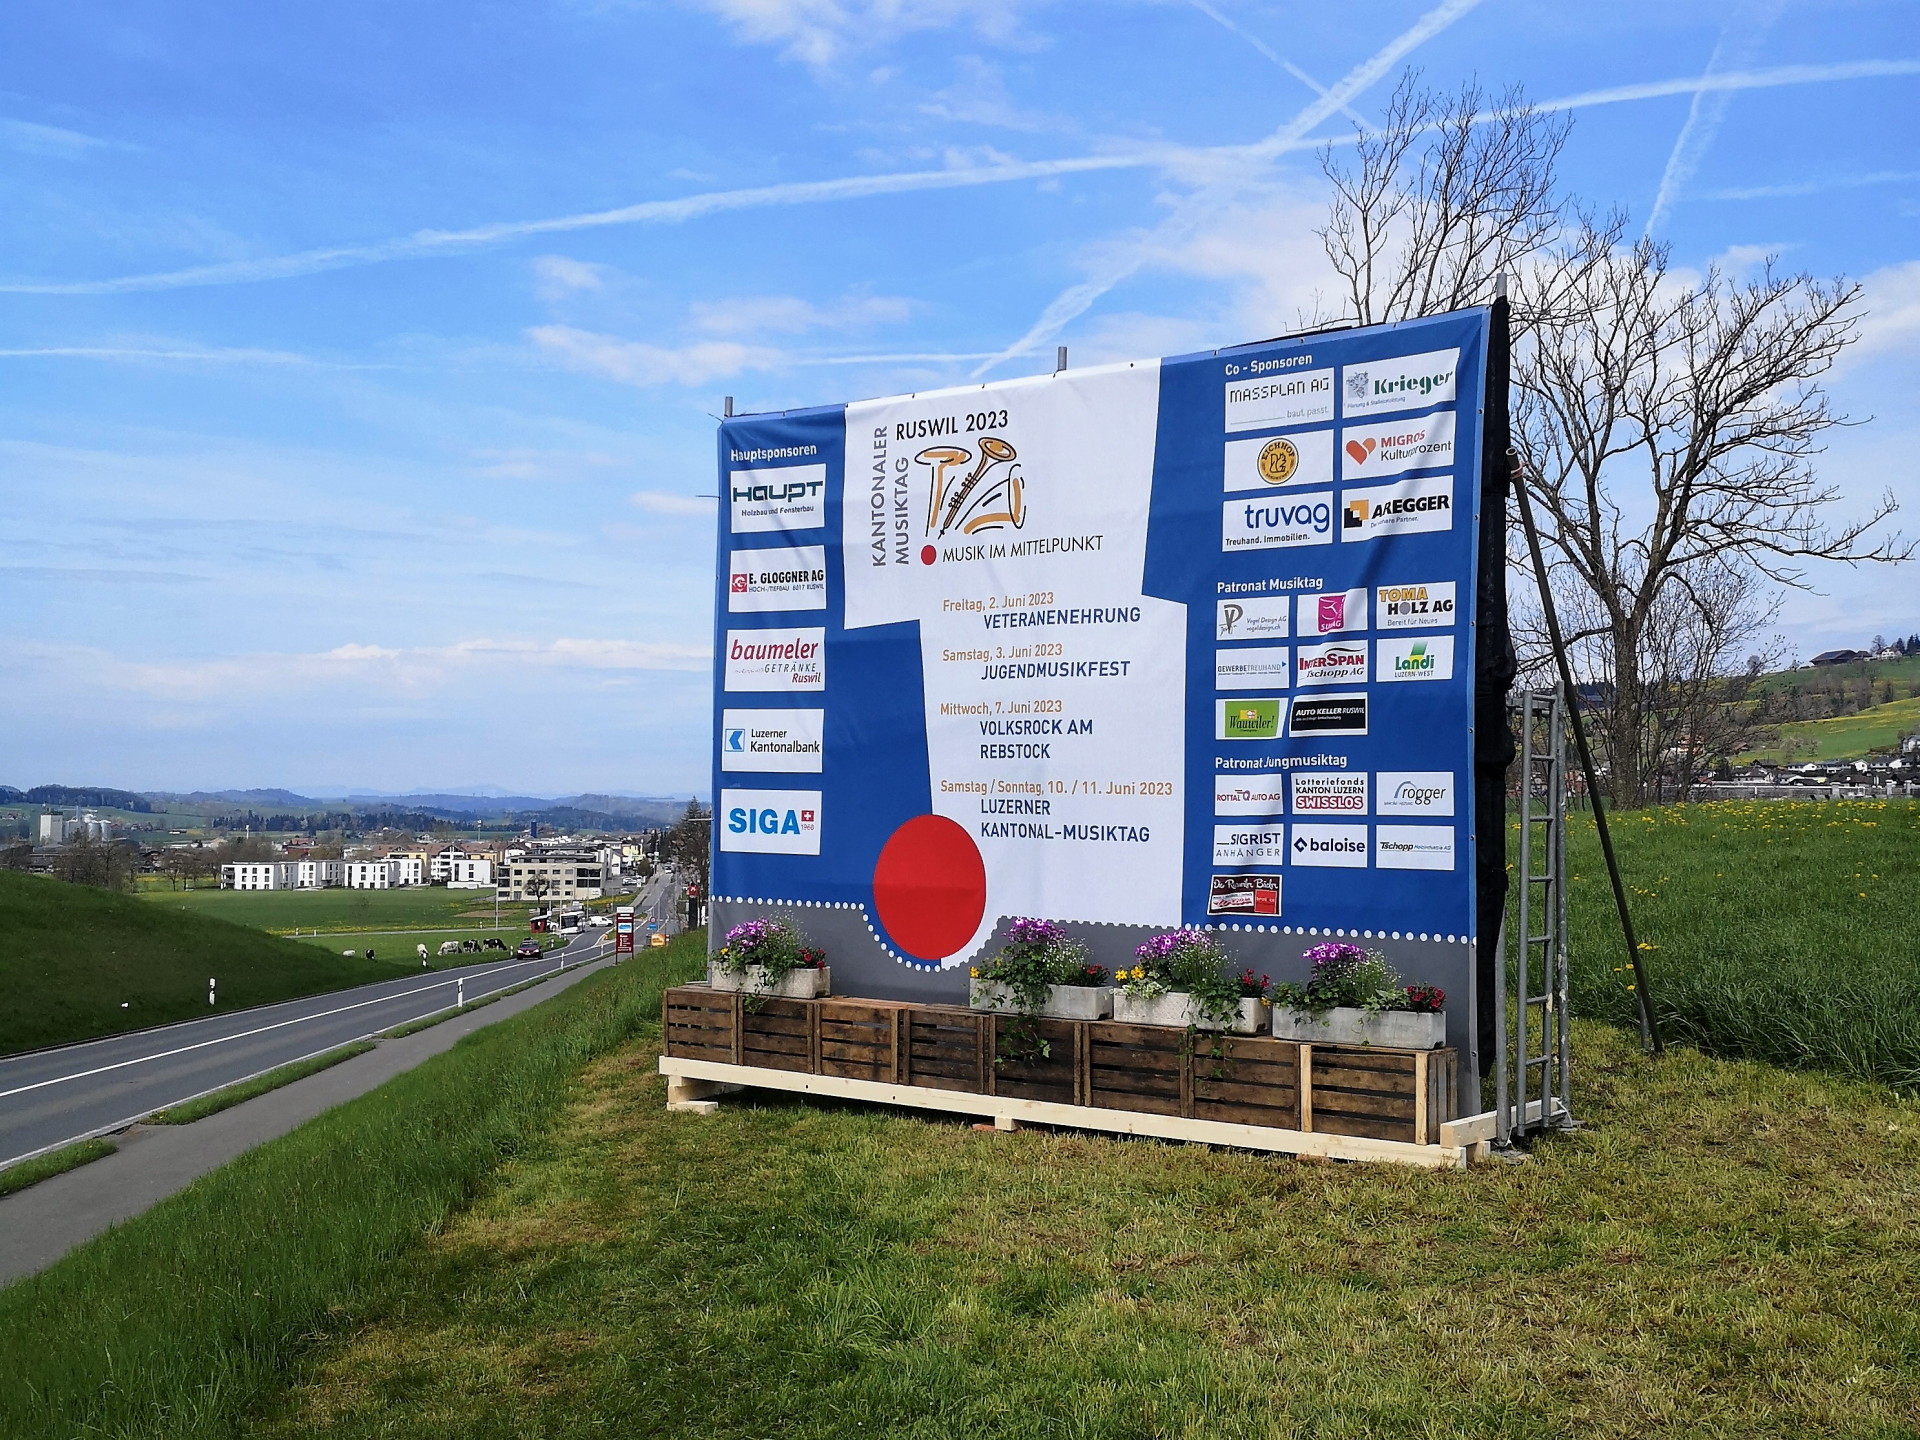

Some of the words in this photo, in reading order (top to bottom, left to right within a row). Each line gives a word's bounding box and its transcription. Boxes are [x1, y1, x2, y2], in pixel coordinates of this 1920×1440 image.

[1225, 363, 1240, 376] Co
[1250, 354, 1313, 374] Sponsoren
[1230, 380, 1305, 403] MASSPLAN
[1311, 377, 1329, 393] AG
[1374, 371, 1453, 395] Krieger
[1307, 406, 1329, 418] passt
[896, 416, 958, 440] RUSWIL
[965, 409, 1008, 432] 2023
[1380, 429, 1426, 448] MIGROS
[730, 444, 817, 463] Hauptsponsoren
[1261, 441, 1295, 460] EICHHOF
[1381, 441, 1452, 461] Kulturprozent
[871, 426, 887, 567] KANTONALER
[741, 508, 768, 517] Holzbau
[779, 505, 814, 514] Fensterbau
[894, 456, 909, 565] MUSIKTAG
[1371, 495, 1450, 519] AREGGER
[1244, 503, 1330, 533] truvag
[1226, 536, 1262, 546] Treuhand.
[1264, 533, 1310, 543] Immobilien.
[942, 544, 985, 563] MUSIK
[990, 543, 1006, 559] IM
[1010, 535, 1104, 557] MITTELPUNKT
[749, 573, 757, 585] E.
[760, 570, 810, 584] GLOGGNER
[811, 569, 824, 582] AG
[1217, 580, 1266, 594] Patronat
[1269, 577, 1323, 590] Musiktag
[943, 597, 986, 612] Freitag,
[989, 597, 1000, 609] 2.
[1002, 594, 1026, 608] Juni
[1028, 592, 1054, 606] 2023
[1379, 587, 1428, 603] TOMA
[1388, 601, 1429, 615] HOLZ
[1432, 599, 1453, 613] AG
[983, 607, 1141, 630] VETERANENEHRUNG
[731, 637, 818, 660] baumeler
[942, 647, 993, 662] Samstag,
[996, 647, 1006, 659] 3.
[1008, 644, 1032, 658] Juni
[1035, 643, 1063, 657] 2023
[764, 661, 816, 673] GETRÄNKE
[981, 660, 1130, 680] JUGENDMUSIKFEST
[1217, 663, 1281, 673] GEWERBETREUHAND
[1395, 654, 1435, 671] Landi
[791, 672, 821, 684] Ruswil
[1306, 668, 1348, 678] Tschopp
[1350, 667, 1365, 676] AG
[1394, 670, 1434, 678] LUZERN-WEST
[940, 702, 992, 716] Mittwoch,
[995, 702, 1005, 715] 7.
[1007, 701, 1031, 714] Juni
[1033, 700, 1063, 713] 2023
[1316, 707, 1342, 715] KELLER
[751, 729, 787, 738] Luzerner
[979, 719, 1063, 736] VOLKSROCK
[1067, 719, 1093, 735] AM
[750, 740, 820, 753] Kantonalbank
[980, 743, 1051, 759] REBSTOCK
[1215, 757, 1264, 769] Patronat
[1263, 754, 1348, 769] Jungmusiktag
[940, 780, 987, 796] Samstag
[997, 780, 1045, 796] Sonntag,
[1048, 780, 1068, 795] 10.
[1082, 781, 1102, 795] 11.
[1105, 781, 1135, 795] Juni
[1139, 782, 1173, 796] 2023
[1295, 777, 1364, 786] Lotteriefonds
[1251, 793, 1268, 801] AUTO
[1268, 793, 1281, 801] AG
[1295, 796, 1363, 809] SWISSLOS
[1402, 788, 1447, 805] rogger
[980, 799, 1051, 815] LUZERNER
[728, 807, 800, 835] SIGA
[981, 822, 1150, 843] KANTONAL-MUSIKTAG
[1230, 832, 1281, 845] SIGRIST
[1216, 847, 1280, 857] ANHÄNGER
[1310, 837, 1366, 853] baloise
[1379, 841, 1414, 852] Tschopp
